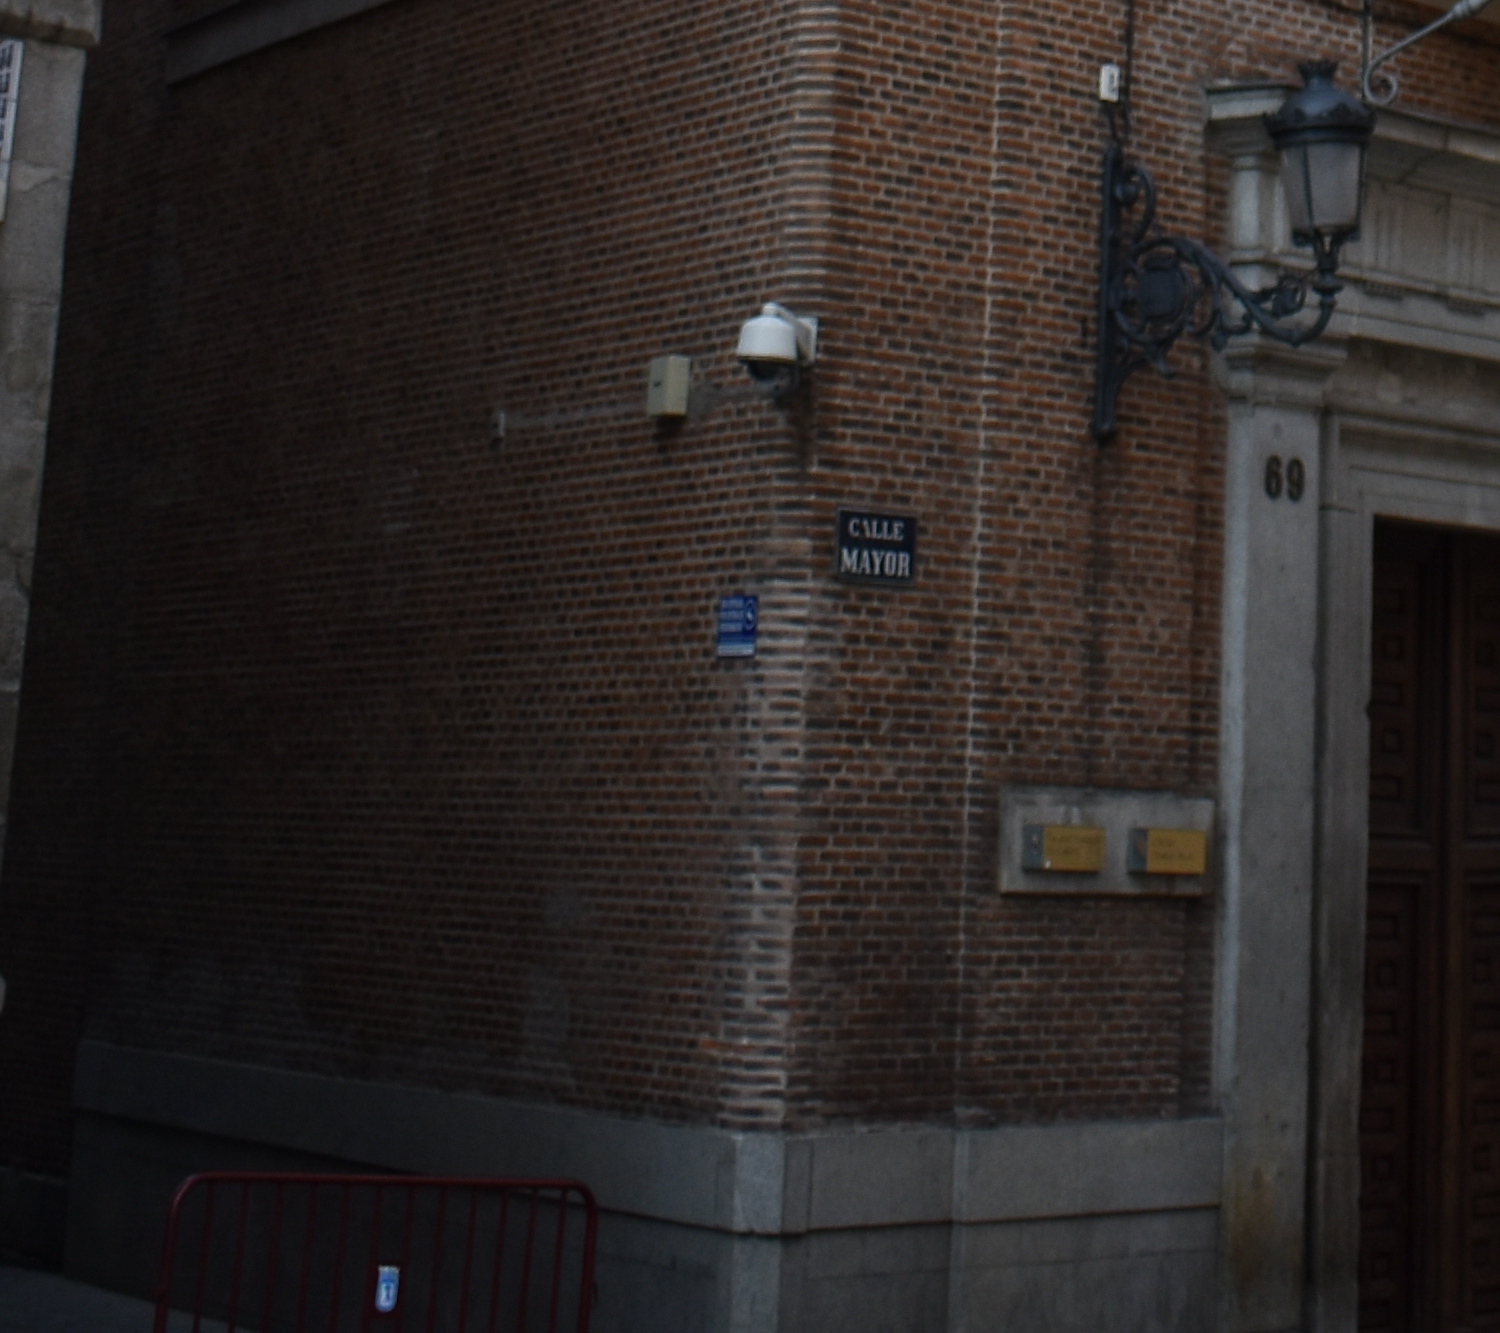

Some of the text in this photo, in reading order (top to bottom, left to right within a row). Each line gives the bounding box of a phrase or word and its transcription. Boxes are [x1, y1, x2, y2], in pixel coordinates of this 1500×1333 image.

[1265, 455, 1305, 502] 69
[848, 517, 905, 541] CALLE
[840, 547, 911, 578] MAYOR
